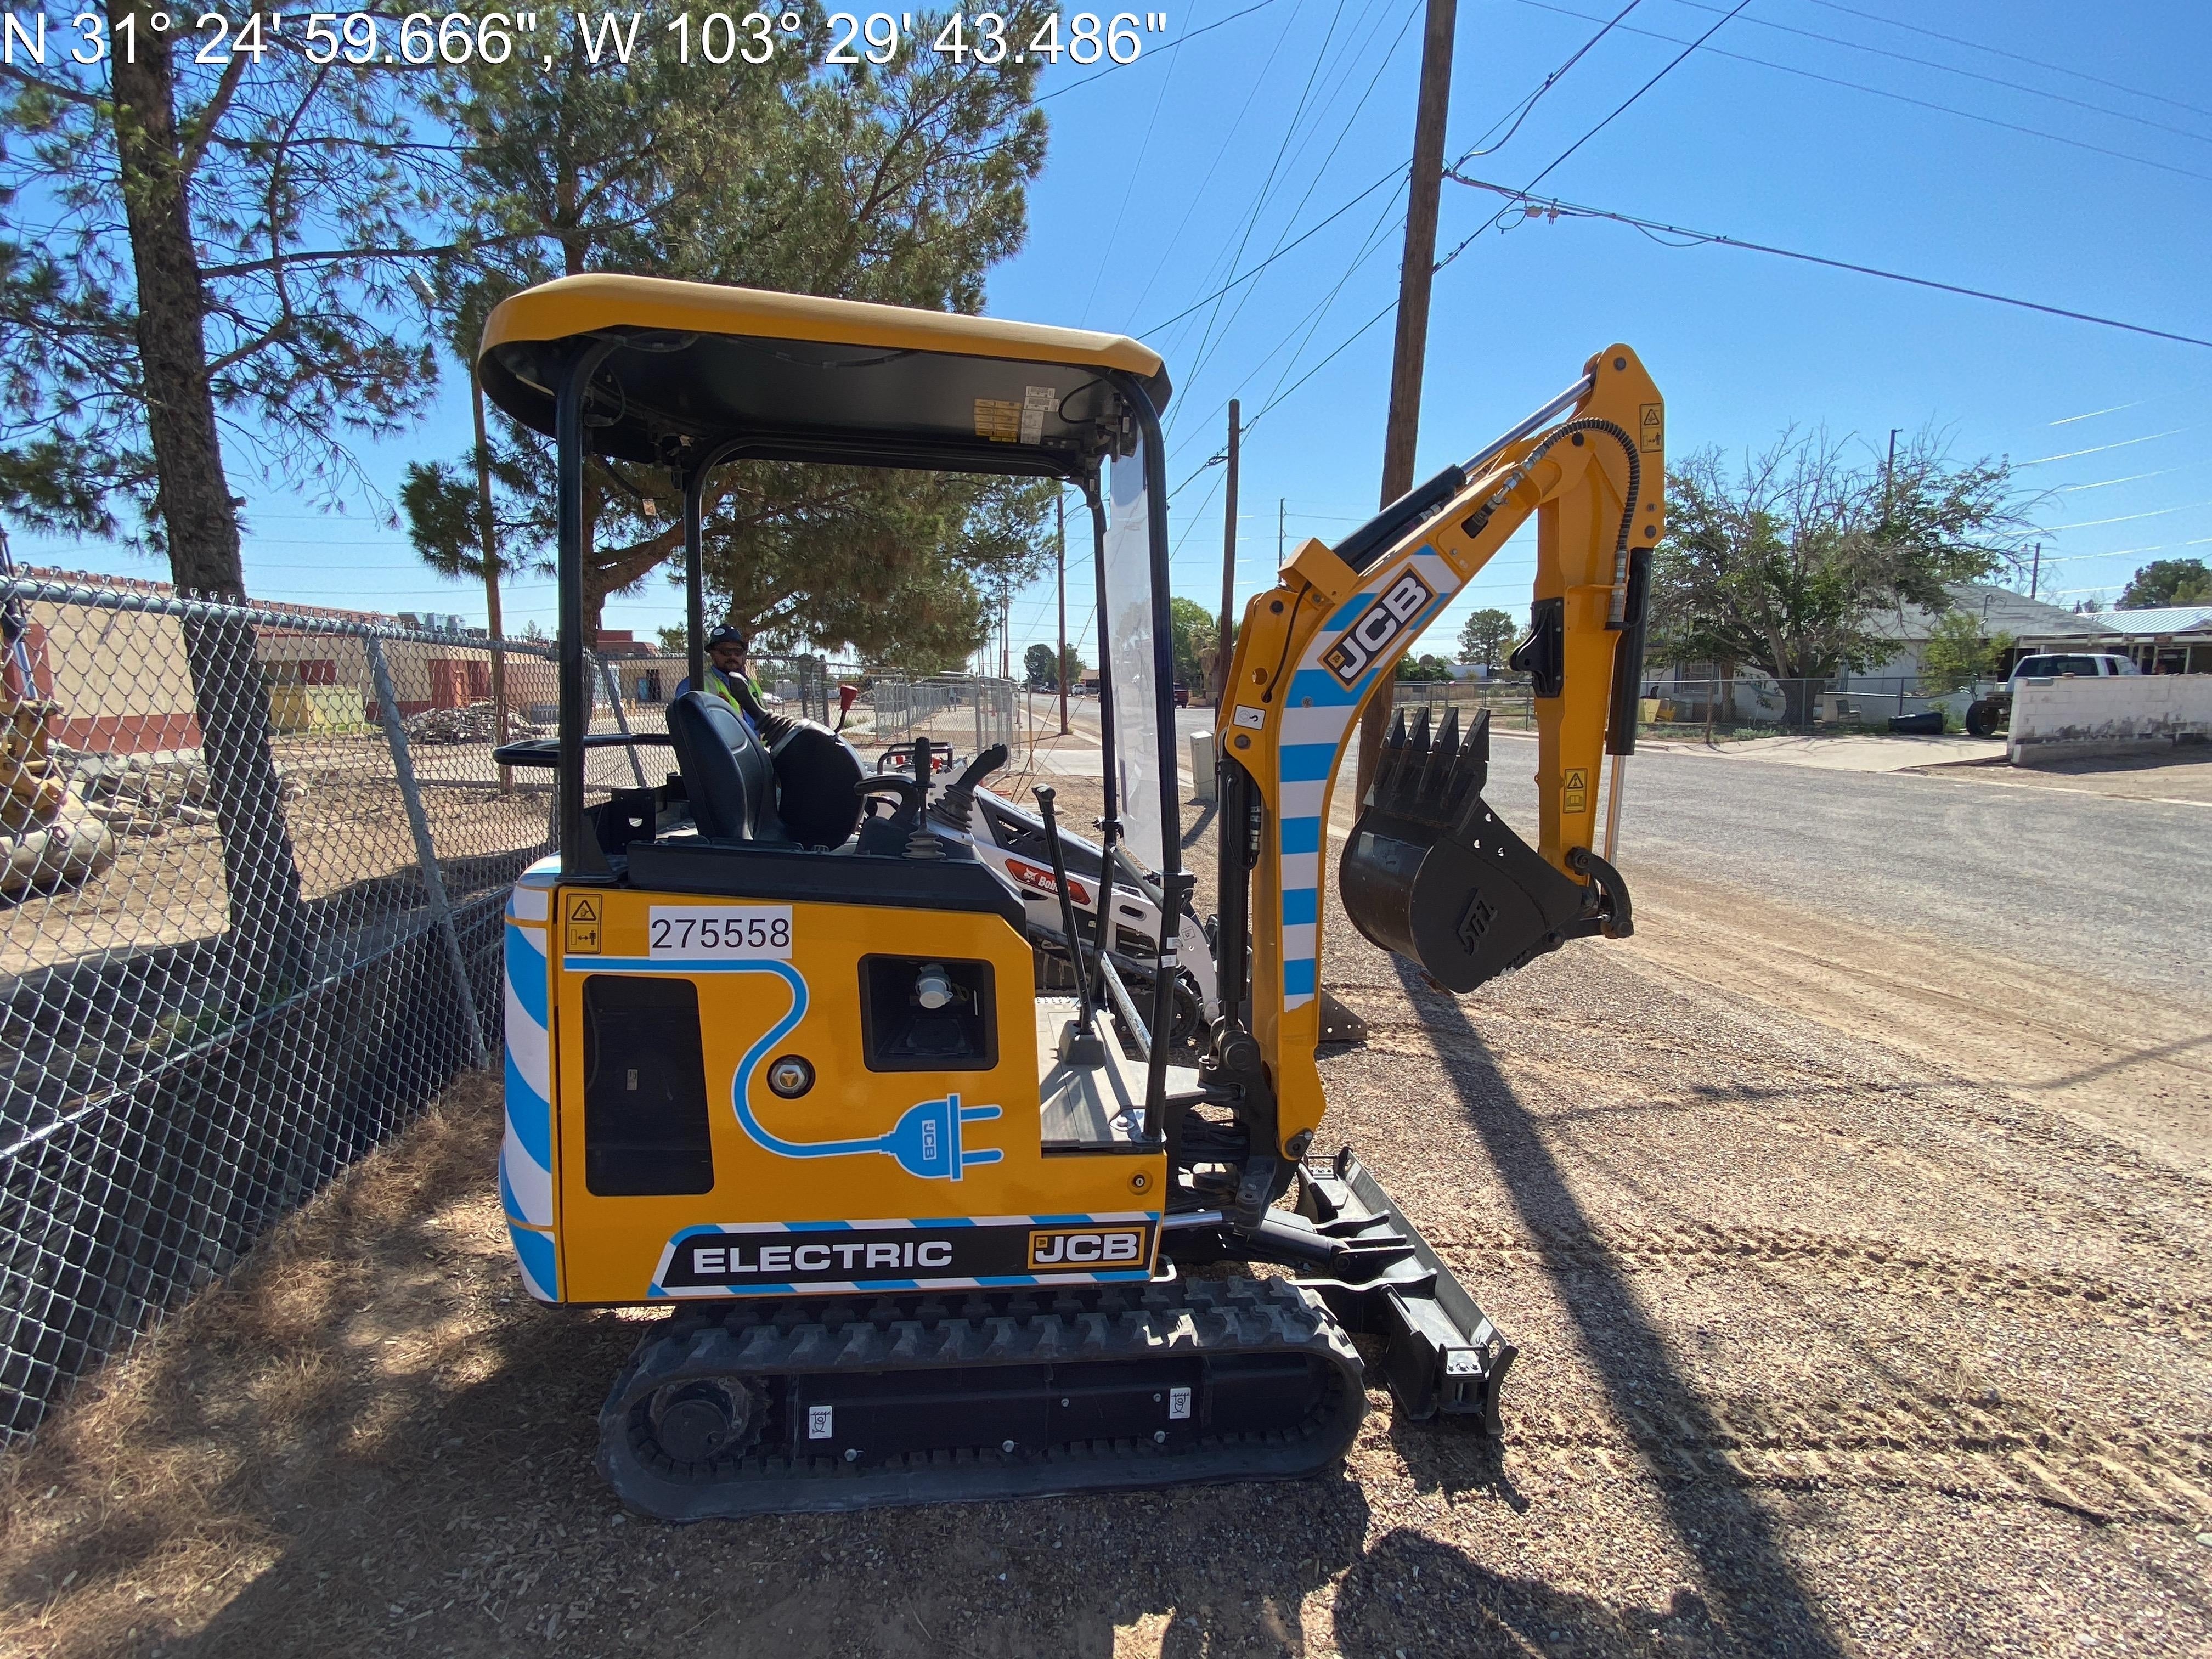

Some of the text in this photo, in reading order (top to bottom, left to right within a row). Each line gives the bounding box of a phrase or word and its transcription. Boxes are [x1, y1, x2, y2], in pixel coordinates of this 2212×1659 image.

[1339, 577, 1427, 679] JCB
[651, 918, 790, 949] 275558
[923, 1123, 935, 1159] JCB
[693, 1233, 1137, 1274] ELECTRIC JCB
